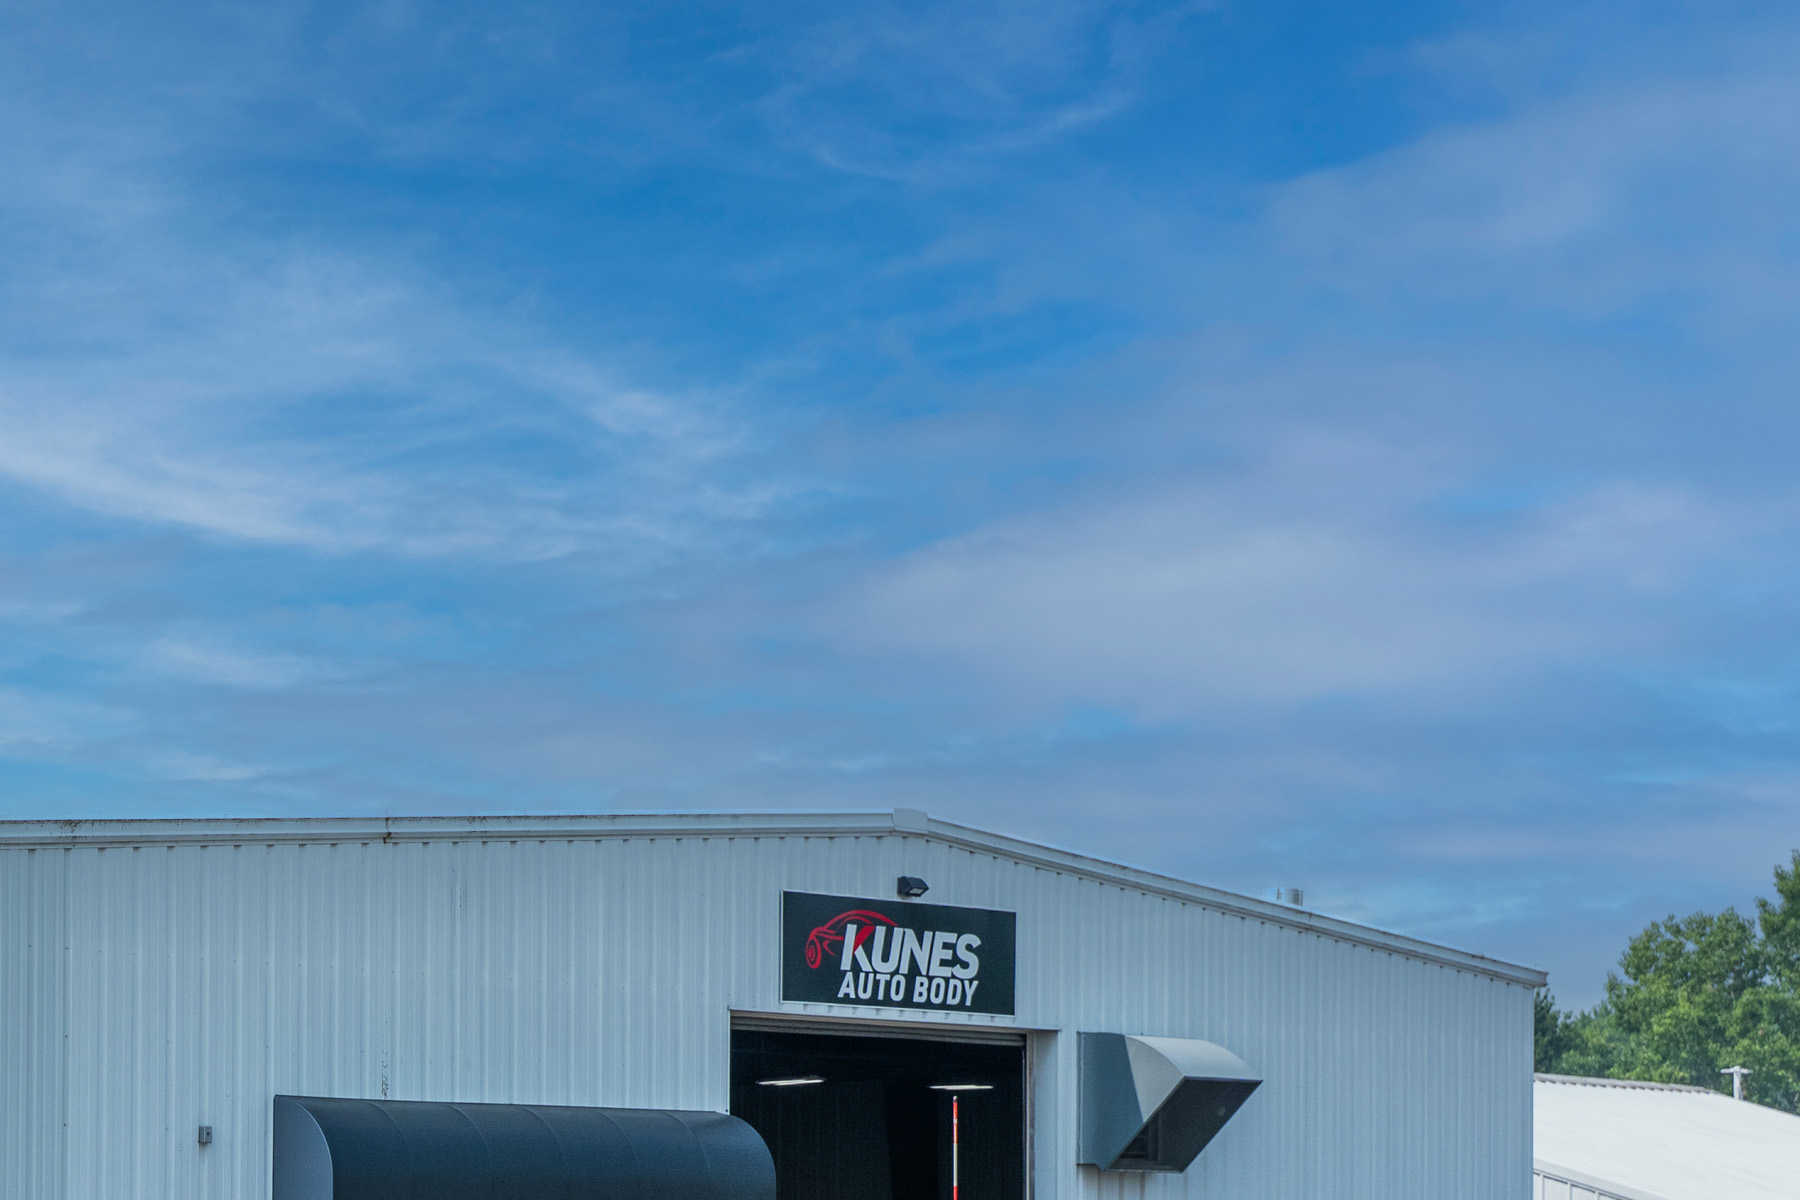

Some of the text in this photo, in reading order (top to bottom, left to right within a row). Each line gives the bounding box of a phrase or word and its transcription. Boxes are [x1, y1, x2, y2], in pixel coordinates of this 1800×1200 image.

[840, 924, 982, 979] KUNES
[837, 972, 978, 1006] AUTO BODY
